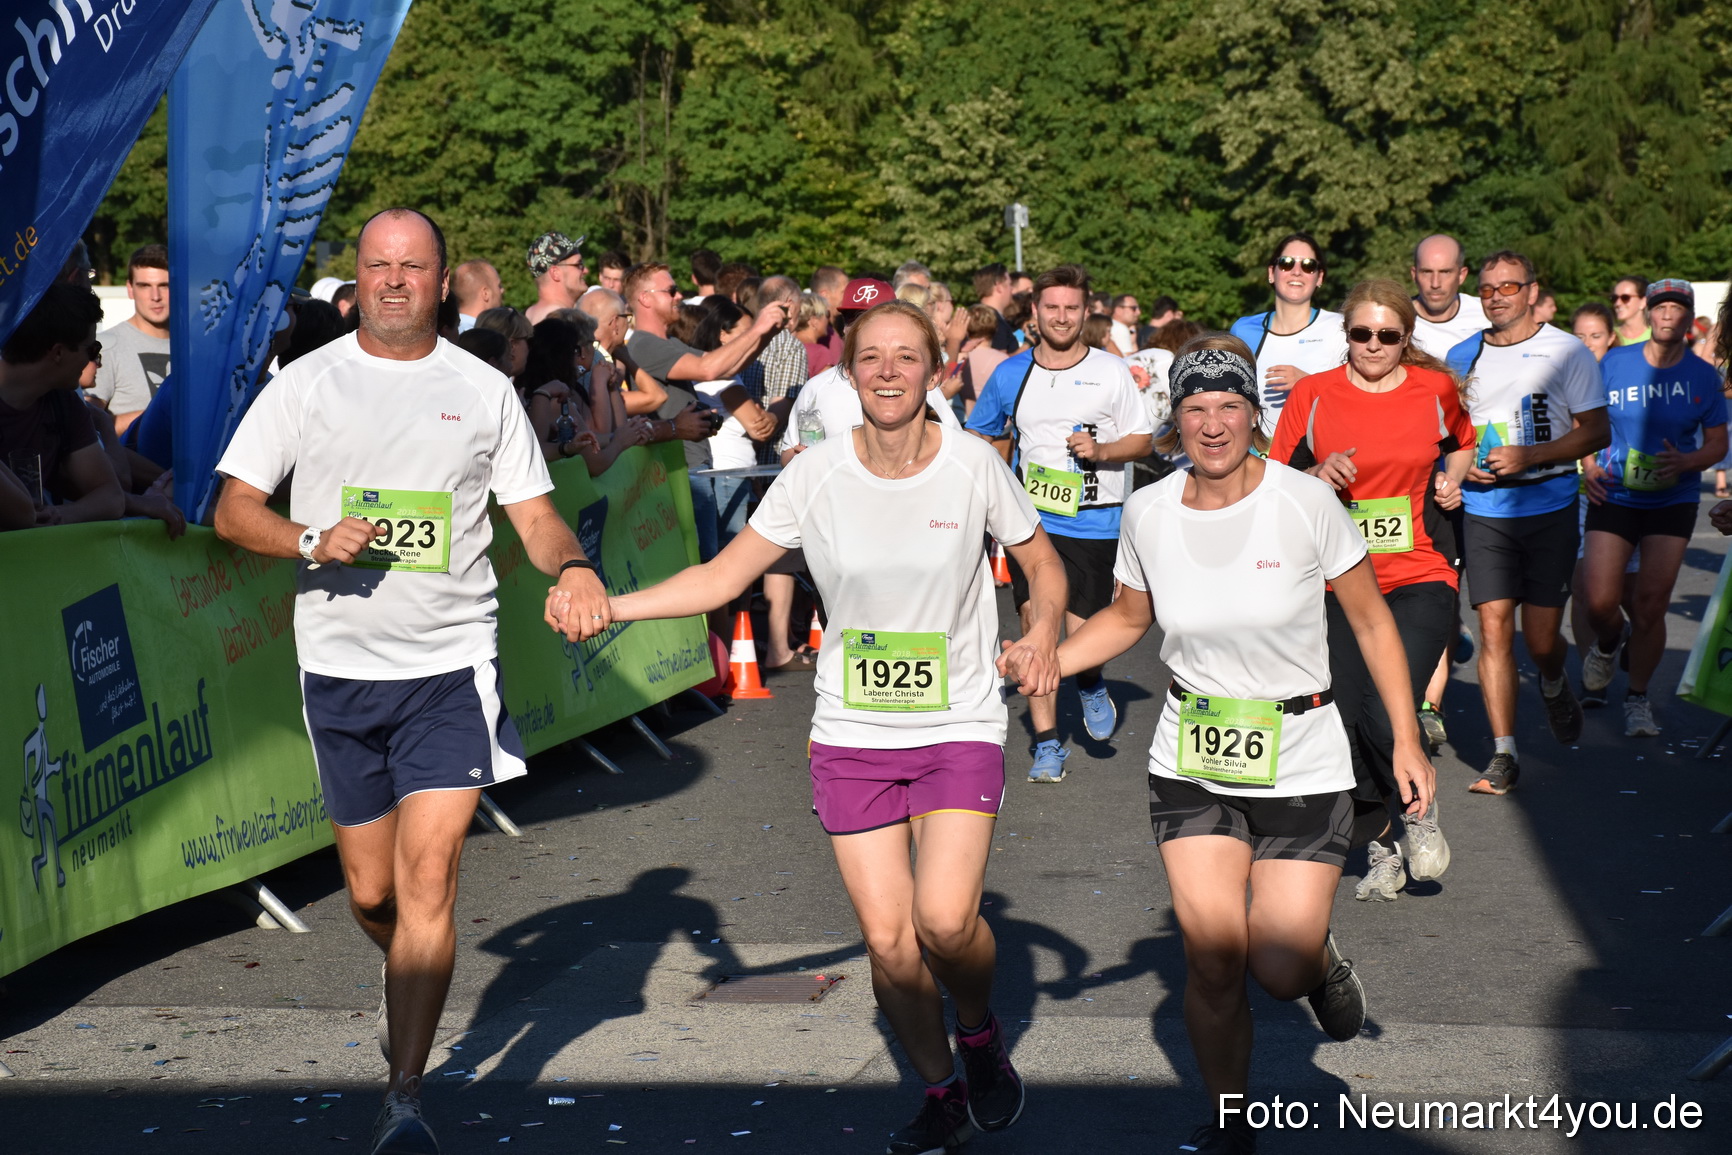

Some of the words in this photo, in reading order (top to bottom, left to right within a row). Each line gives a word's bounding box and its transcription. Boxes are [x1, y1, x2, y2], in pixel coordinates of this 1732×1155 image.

[441, 412, 461, 421] René
[1029, 480, 1072, 503] 2108
[355, 500, 393, 510] firmenlauf
[930, 520, 958, 529] Christa
[363, 517, 436, 549] 923
[368, 547, 397, 556] Decker
[400, 549, 421, 557] Rene
[1257, 560, 1280, 569] Silvia
[855, 642, 888, 651] firmenlauf
[80, 636, 120, 673] Fischer
[88, 660, 121, 686] AUTOMOBILE
[856, 659, 933, 689] 1925
[863, 689, 892, 697] Laberer
[895, 690, 925, 698] Christa
[871, 697, 916, 705] Strahlentherapie
[1190, 706, 1222, 718] firmenlauf
[1190, 724, 1264, 760] 1926
[62, 677, 213, 838] firmenlauf
[1201, 756, 1222, 765] Vohler
[1224, 759, 1247, 768] Silvia
[1203, 765, 1243, 775] Strahlentherapie
[72, 808, 133, 872] neumarkt
